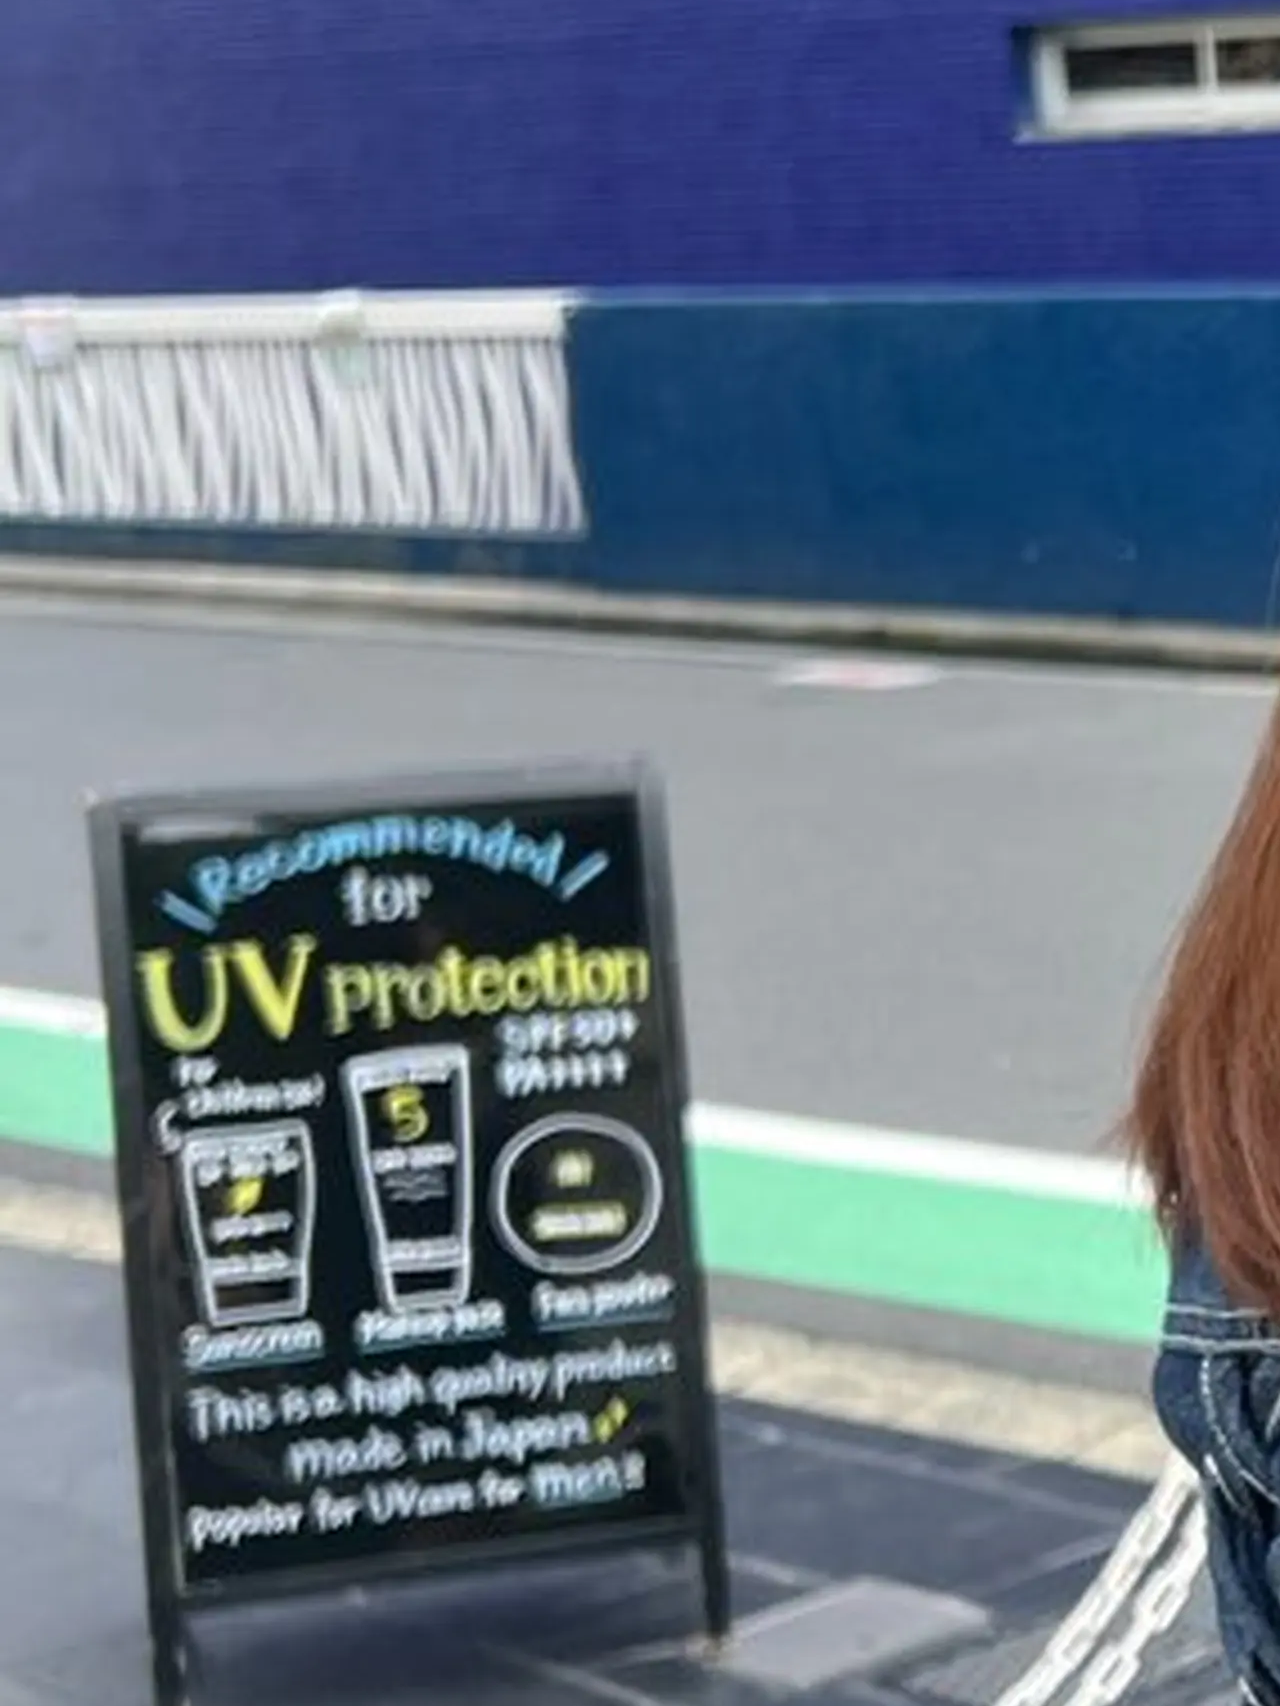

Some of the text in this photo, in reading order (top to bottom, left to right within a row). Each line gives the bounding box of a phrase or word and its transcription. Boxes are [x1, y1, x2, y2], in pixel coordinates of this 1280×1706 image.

[191, 813, 565, 915] Recommended
[341, 866, 432, 927] for
[136, 933, 650, 1053] UV protection
[190, 1386, 271, 1443] This
[553, 1338, 677, 1402] product
[287, 1405, 590, 1483] made in Japan
